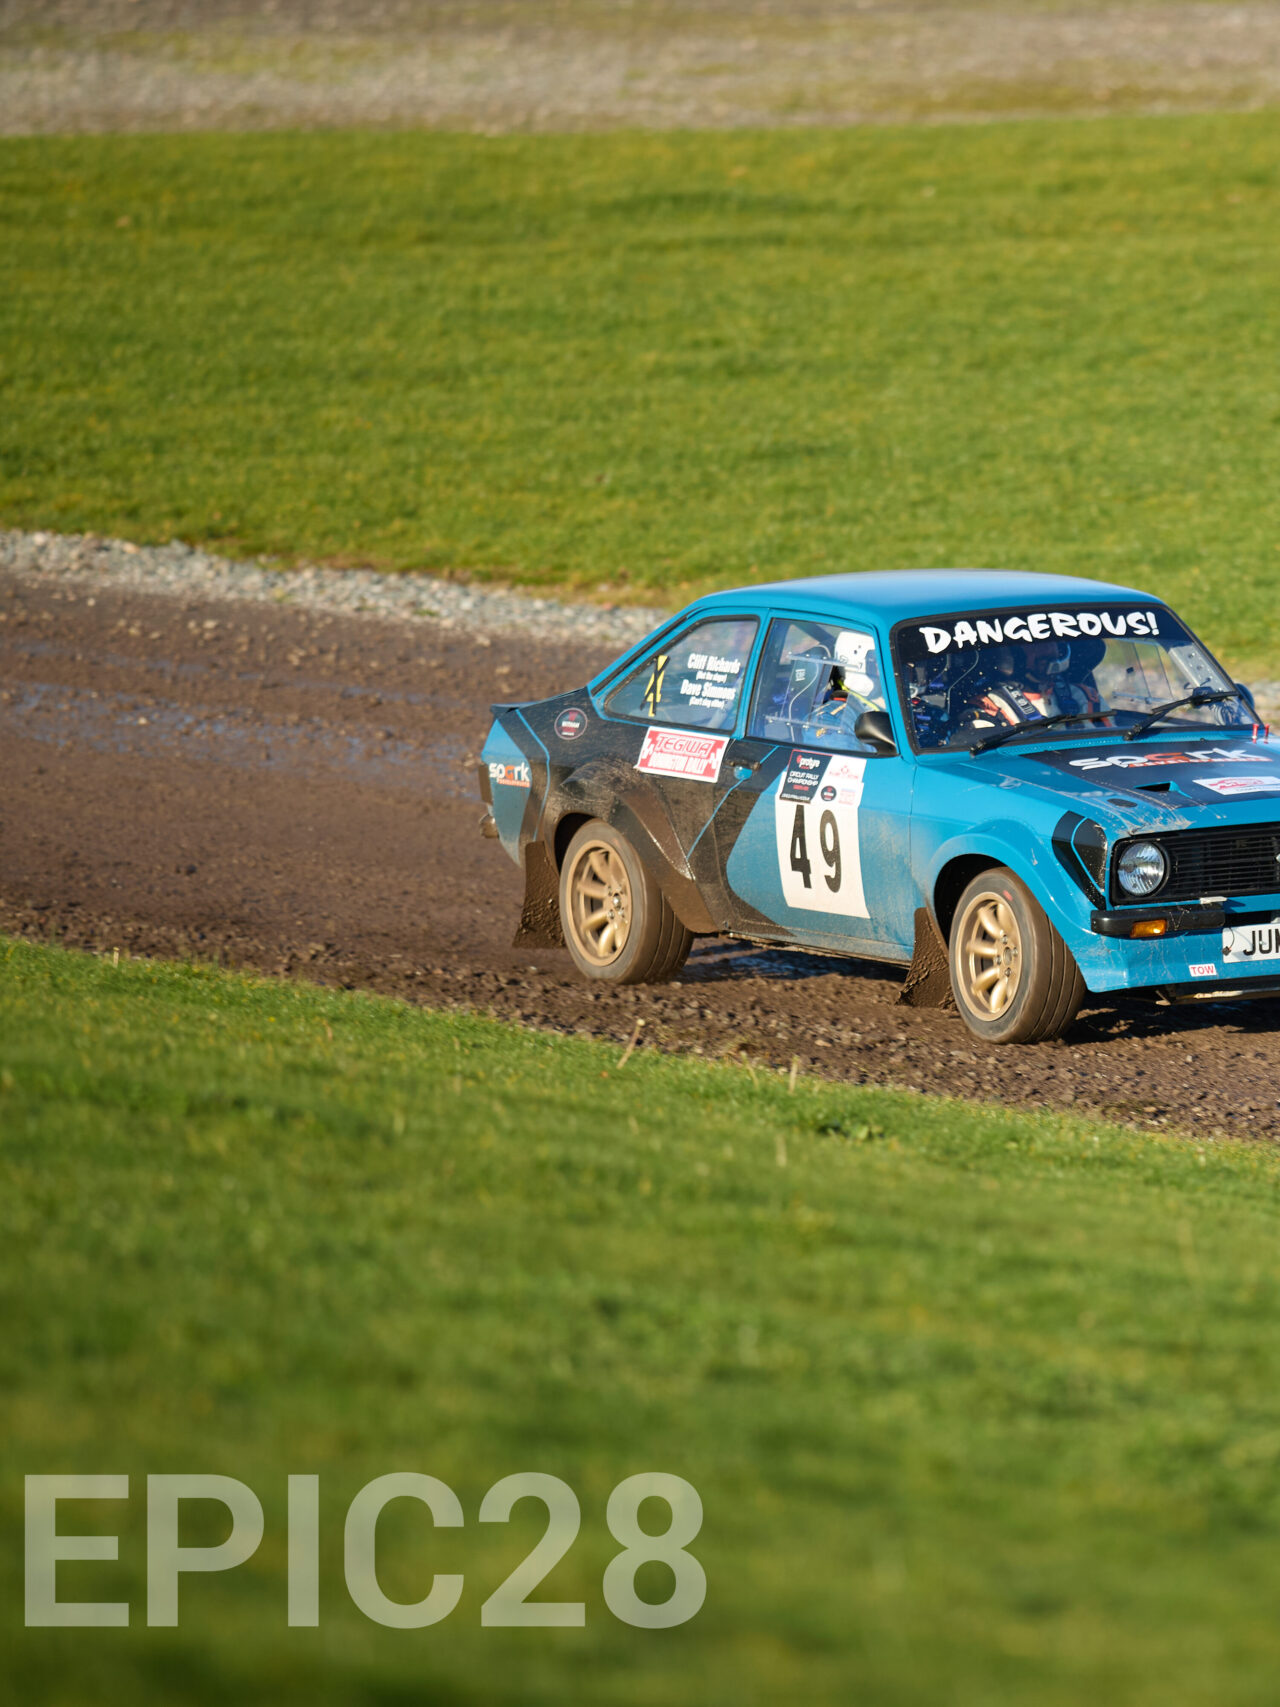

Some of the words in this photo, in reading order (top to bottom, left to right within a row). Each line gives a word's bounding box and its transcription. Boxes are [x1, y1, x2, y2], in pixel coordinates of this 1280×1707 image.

[919, 611, 1160, 654] DANGEROUS!
[687, 652, 709, 670] Cliff
[680, 678, 702, 697] Dave
[656, 735, 713, 757] TEGIWA
[489, 762, 530, 783] spark
[790, 805, 842, 893] 49
[1191, 965, 1215, 975] TOW
